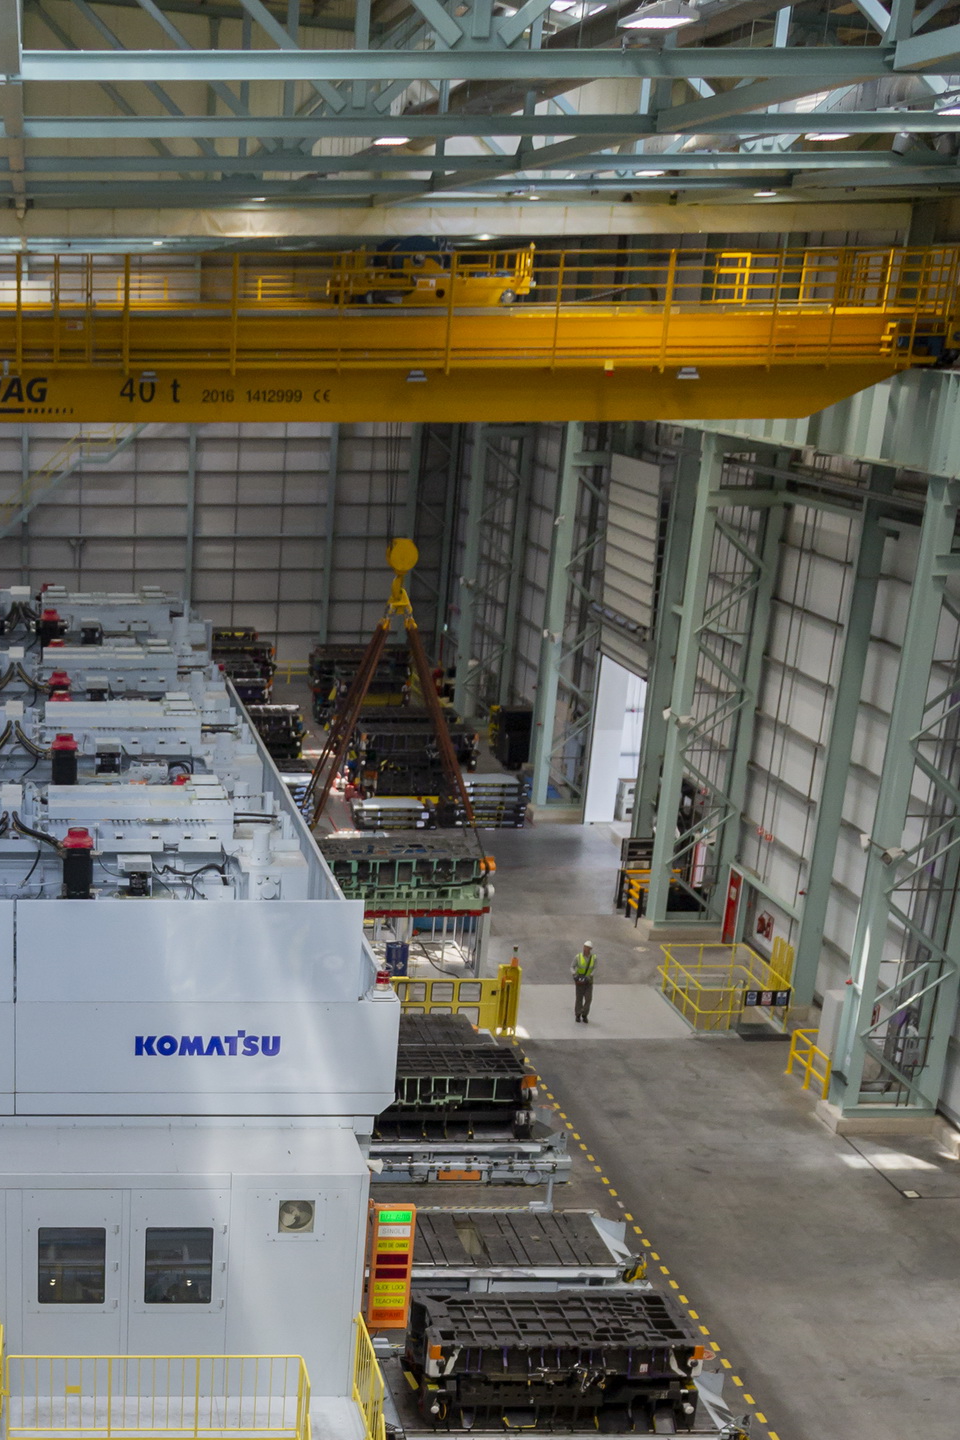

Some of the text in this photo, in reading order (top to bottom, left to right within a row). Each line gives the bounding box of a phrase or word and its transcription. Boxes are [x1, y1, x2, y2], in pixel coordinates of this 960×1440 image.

[119, 378, 181, 403] 40 t
[201, 389, 235, 403] 2016
[246, 389, 303, 403] 1412999
[134, 1029, 282, 1057] KOMATSU
